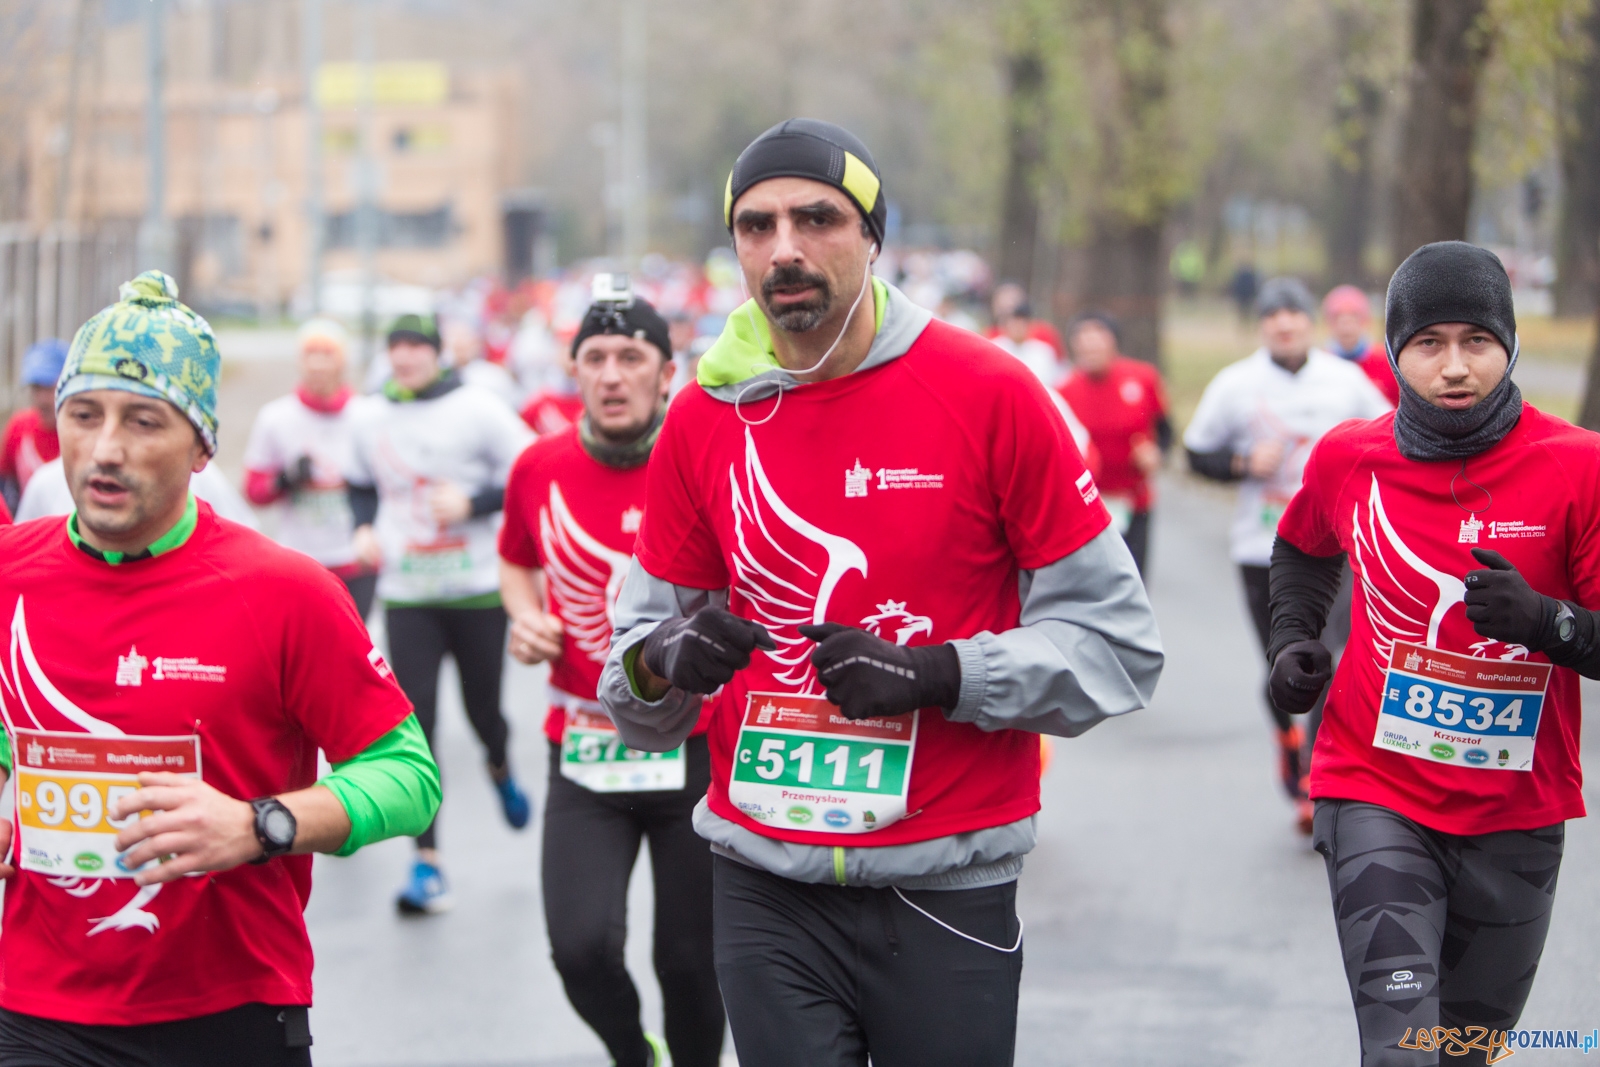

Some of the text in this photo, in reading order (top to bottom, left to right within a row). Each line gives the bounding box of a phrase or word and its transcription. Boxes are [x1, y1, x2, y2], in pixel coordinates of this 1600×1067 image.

[876, 468, 889, 490] 1
[1488, 521, 1497, 539] 1
[1476, 672, 1537, 684] RunPoland.org
[1389, 684, 1523, 732] E 8534
[1382, 738, 1411, 750] LUXMED
[1383, 731, 1408, 743] GRUPA
[1433, 730, 1482, 746] Krzysztof
[107, 753, 185, 767] RunPoland.org
[739, 738, 885, 789] C 5111
[782, 790, 848, 804] Przemysław
[1386, 981, 1422, 991] Kalenji
